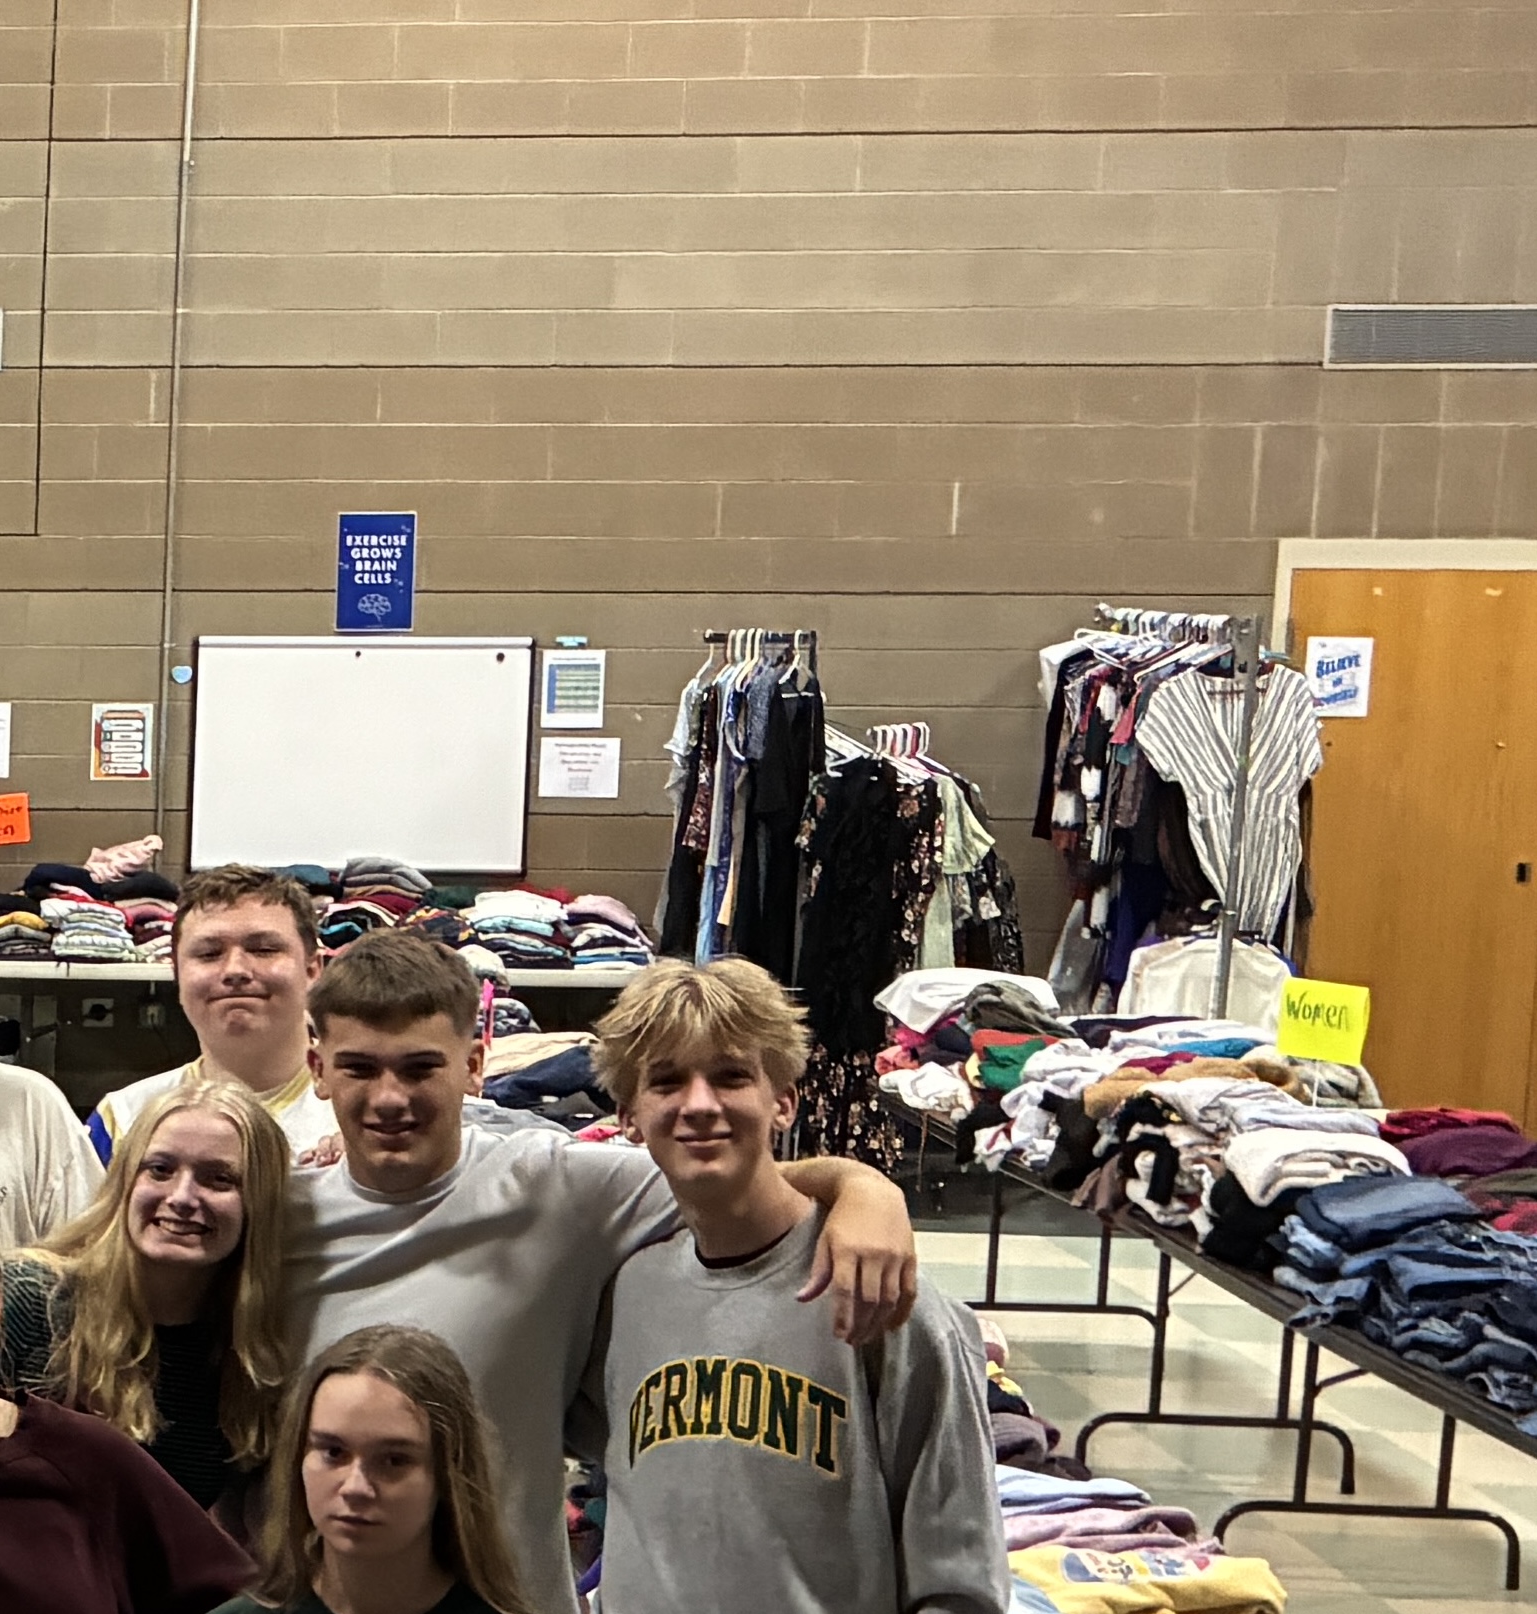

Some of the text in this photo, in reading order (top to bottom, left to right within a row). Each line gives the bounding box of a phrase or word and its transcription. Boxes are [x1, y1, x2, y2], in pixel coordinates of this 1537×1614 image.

[346, 535, 408, 547] EXERCISE
[351, 547, 403, 559] GROWS
[354, 560, 397, 572] BRAIN
[354, 573, 393, 585] CELLS
[629, 1357, 849, 1479] VERMONT
